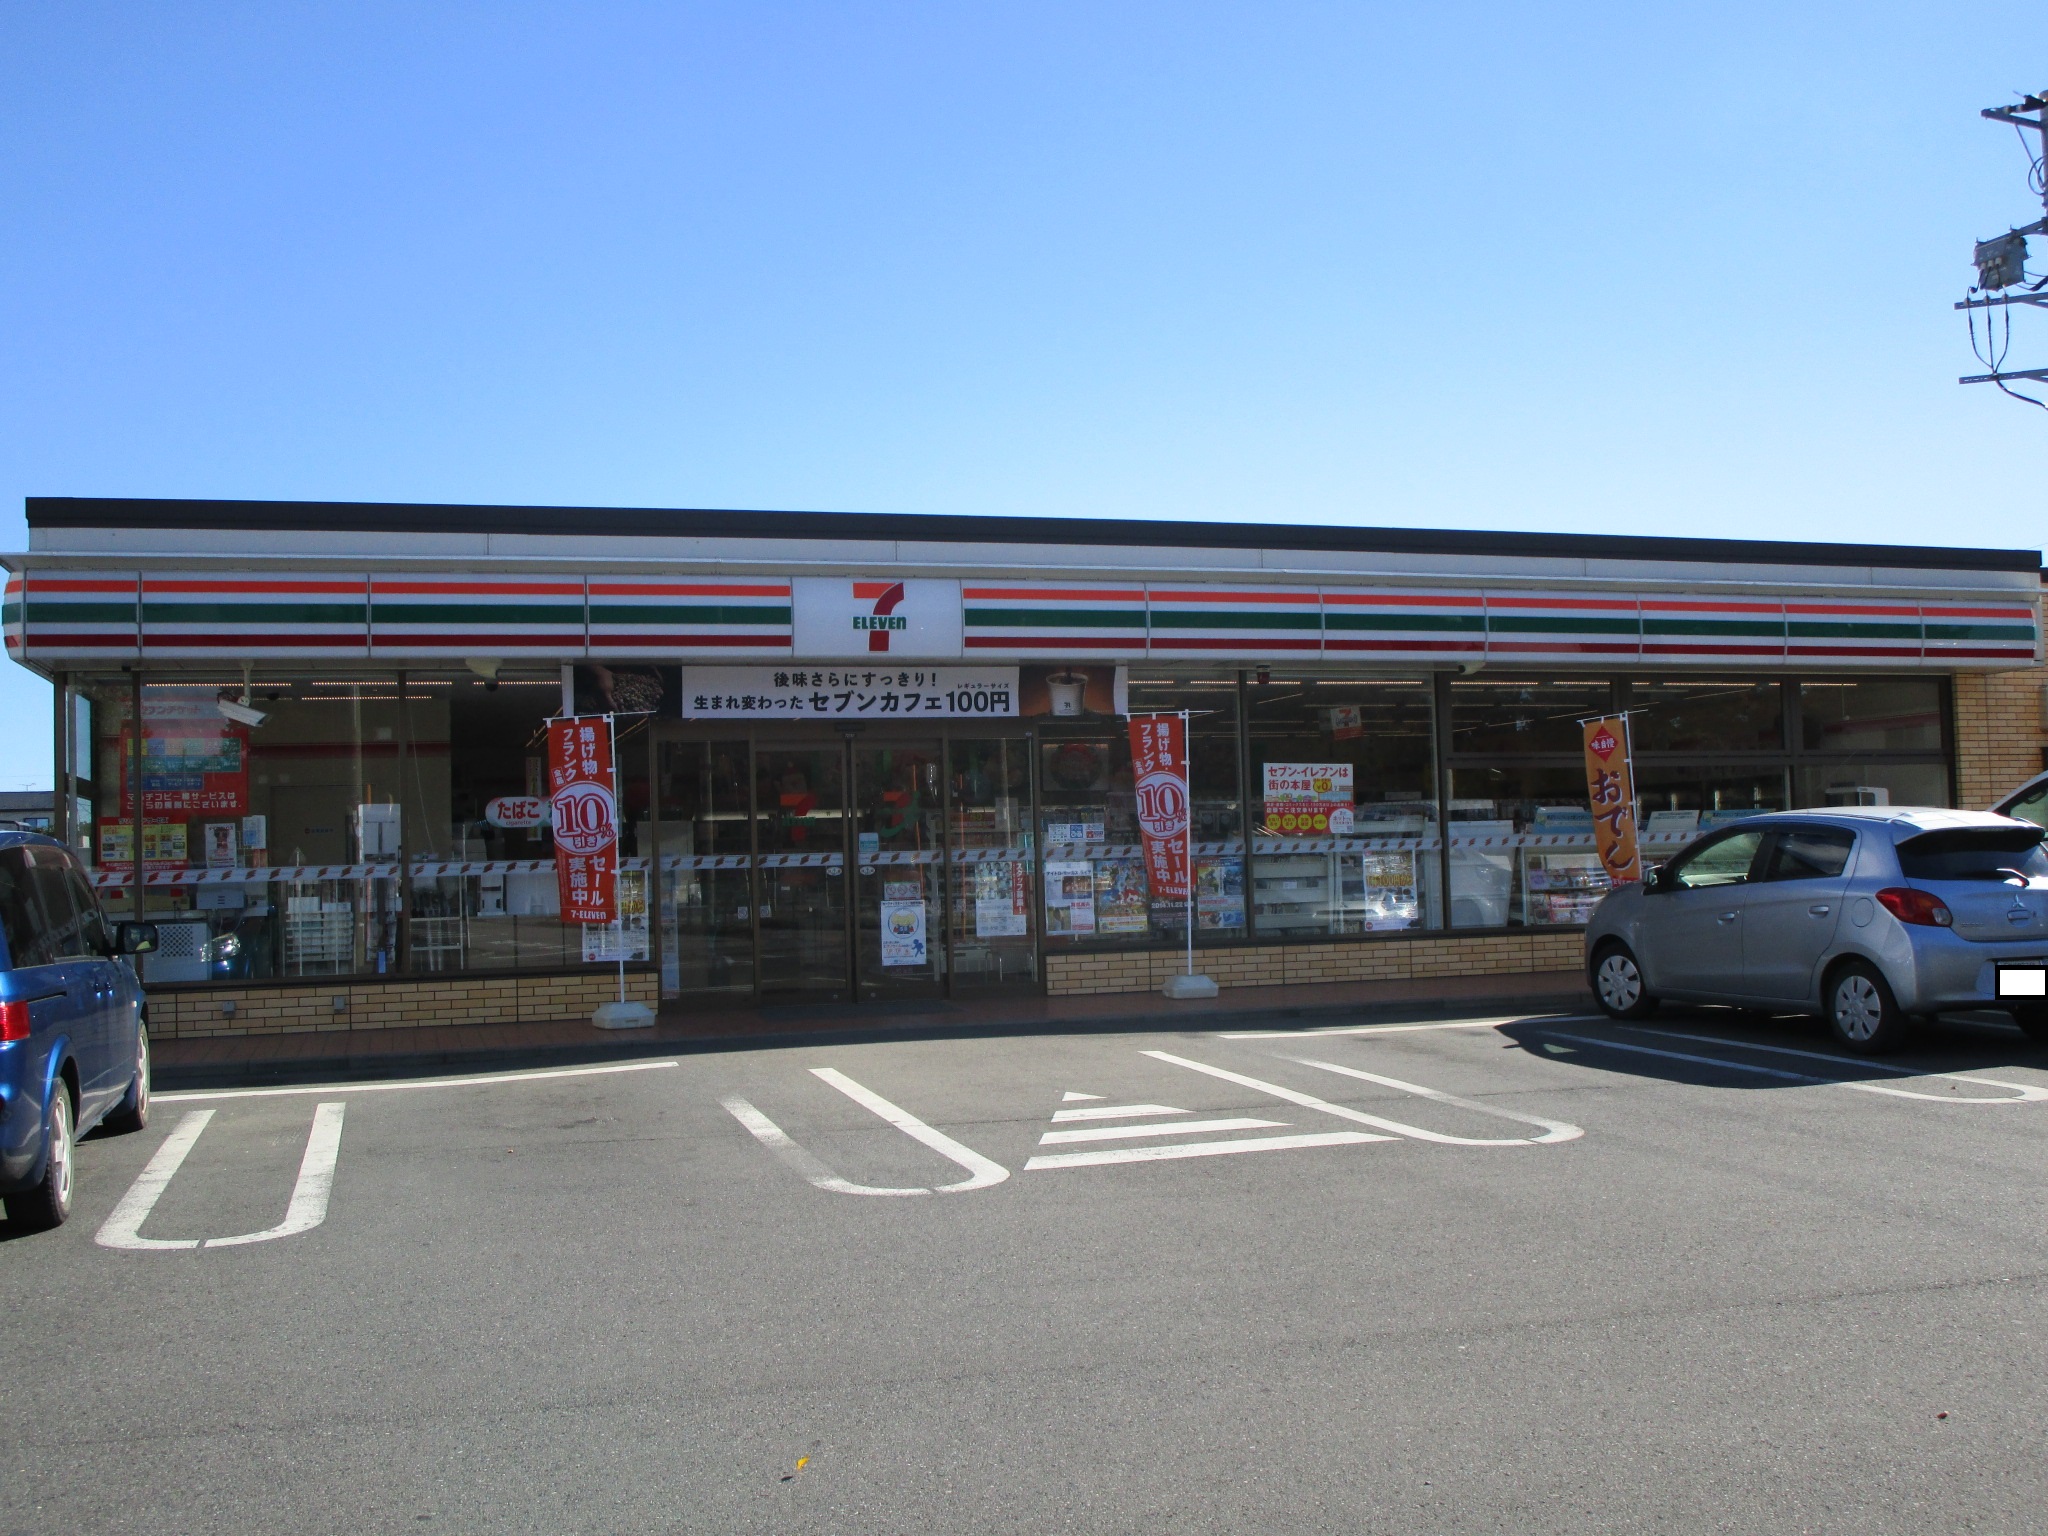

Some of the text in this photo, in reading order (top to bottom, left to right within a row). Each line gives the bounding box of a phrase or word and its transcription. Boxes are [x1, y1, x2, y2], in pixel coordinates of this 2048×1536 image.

[563, 728, 577, 782] フランク
[1140, 723, 1155, 772] フランク
[1268, 779, 1312, 791] 街の本屋
[497, 801, 541, 819] たばこ
[1152, 820, 1175, 833] 引き
[1590, 767, 1635, 872] おでん
[573, 835, 598, 849] 引き
[1150, 840, 1171, 883] 実施中
[1167, 839, 1189, 884] セール
[568, 856, 588, 906] 実施中
[589, 855, 606, 907] セール
